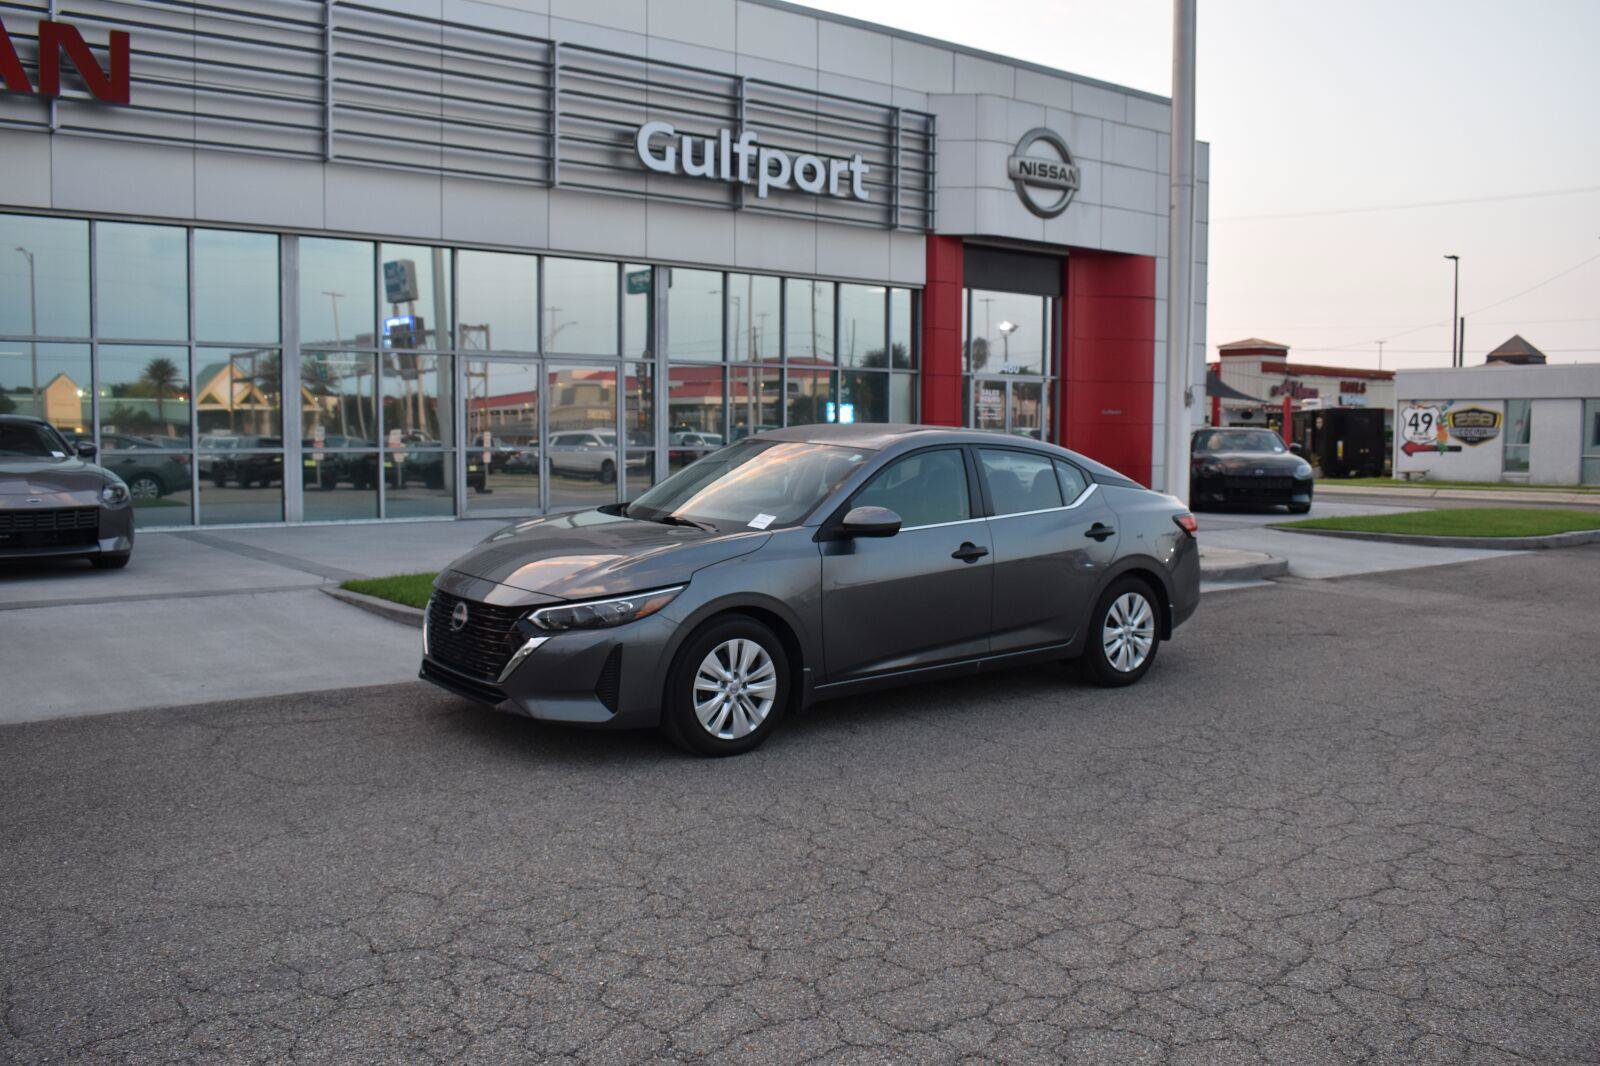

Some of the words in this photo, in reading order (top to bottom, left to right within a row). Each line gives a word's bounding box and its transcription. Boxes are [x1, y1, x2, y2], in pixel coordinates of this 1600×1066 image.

[637, 121, 870, 200] Gulfport
[1019, 161, 1077, 184] NISSAN
[1408, 412, 1433, 433] 49
